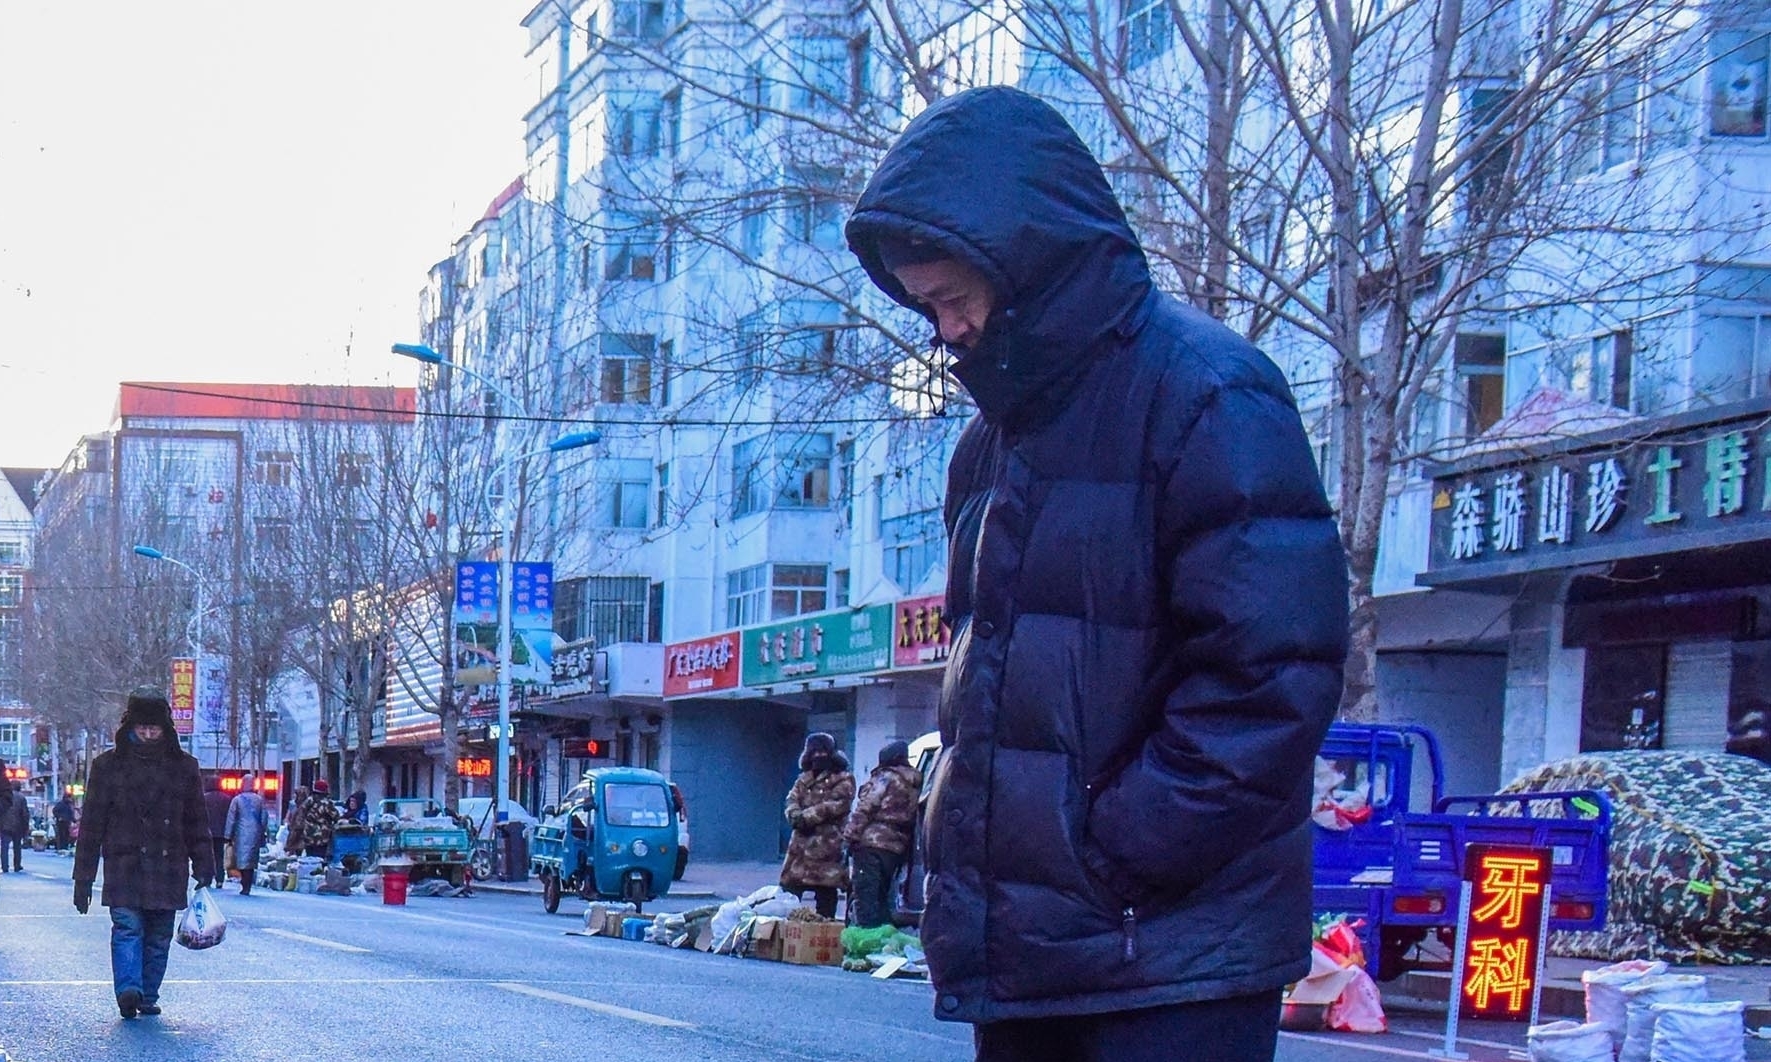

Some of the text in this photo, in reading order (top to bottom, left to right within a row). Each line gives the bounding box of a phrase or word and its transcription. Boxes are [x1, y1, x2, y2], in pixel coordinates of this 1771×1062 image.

[173, 661, 193, 708] 中国黄金
[1464, 856, 1540, 1011] 牙科
